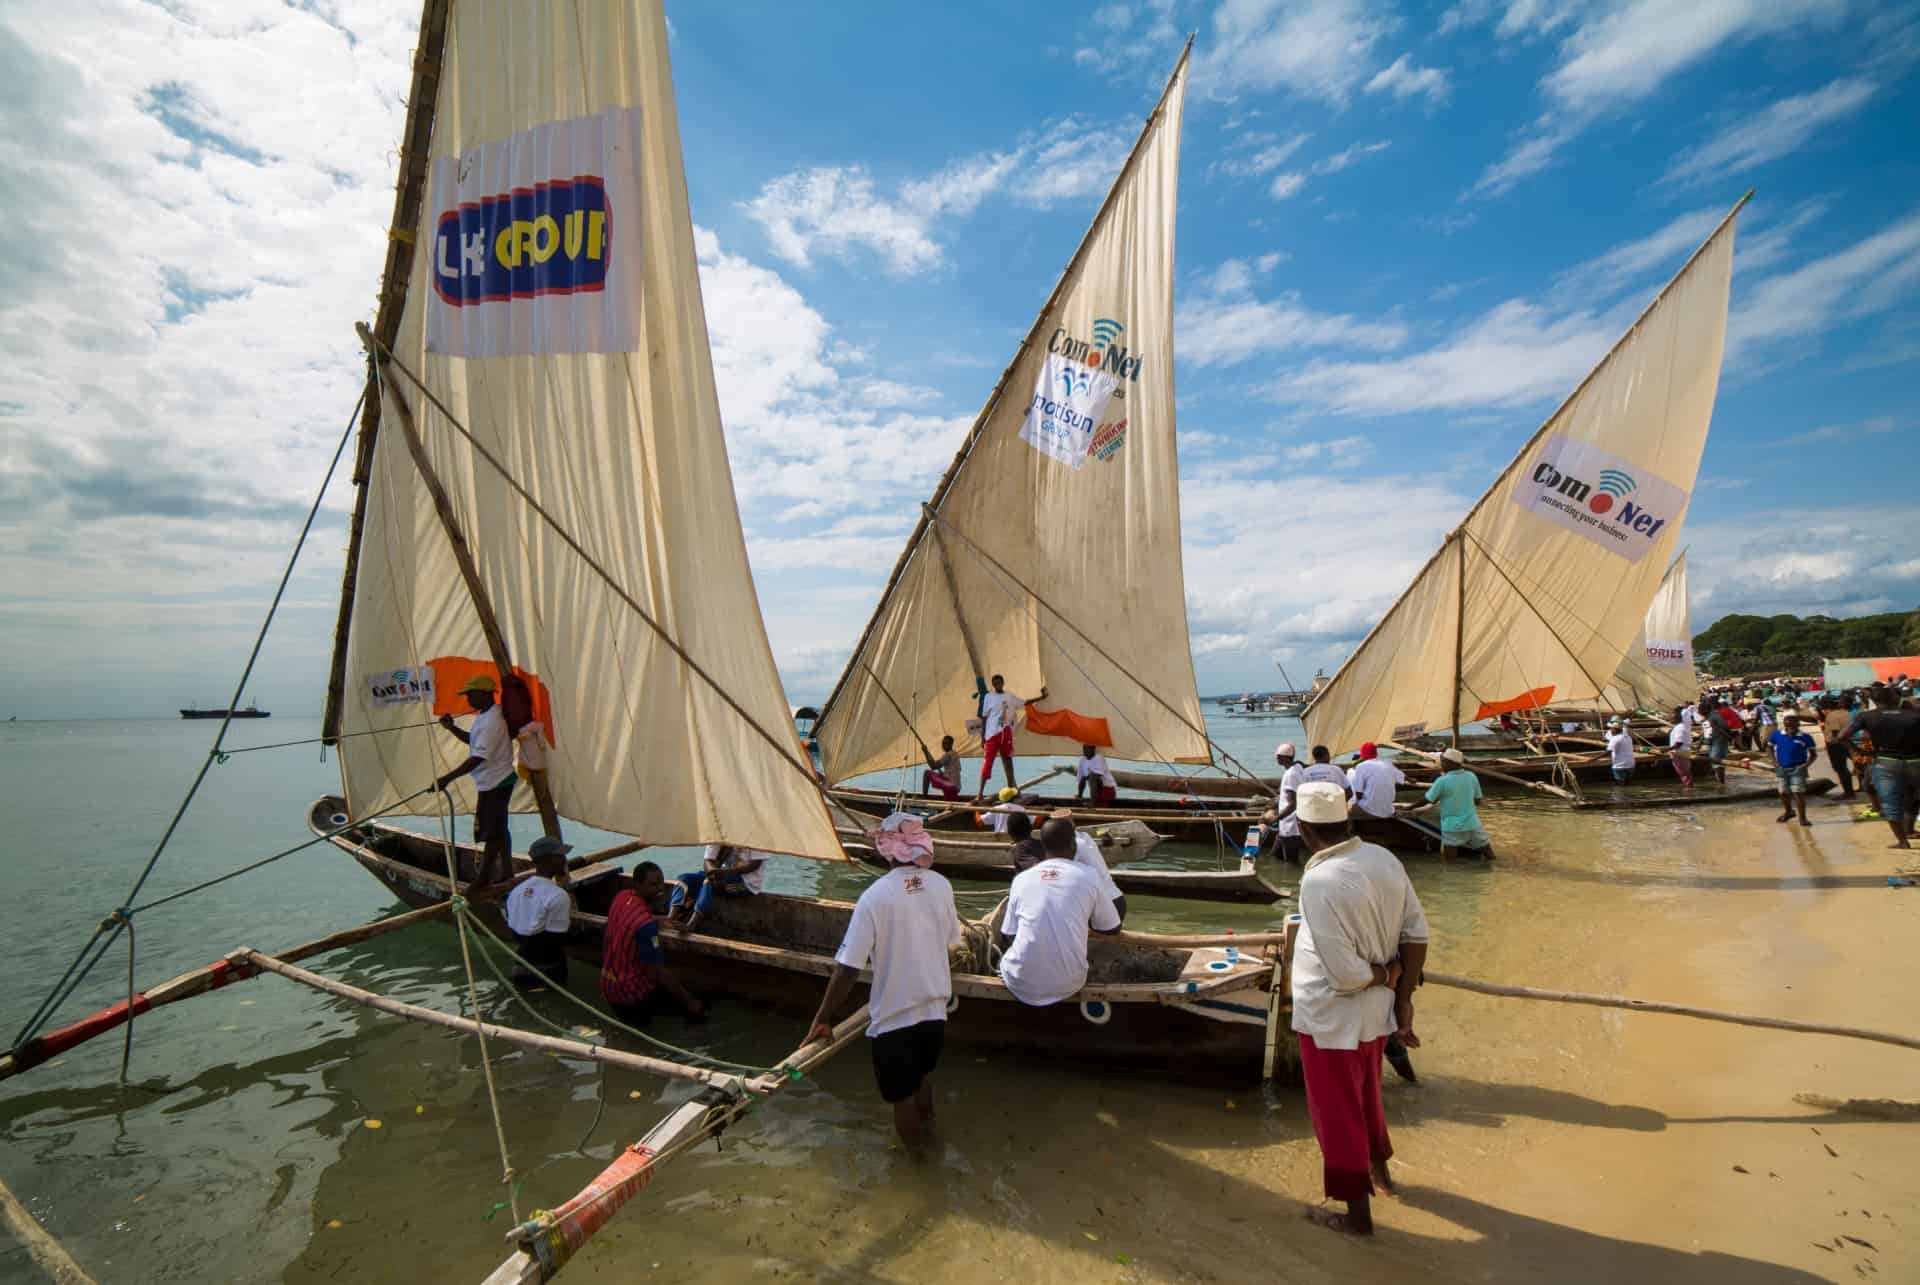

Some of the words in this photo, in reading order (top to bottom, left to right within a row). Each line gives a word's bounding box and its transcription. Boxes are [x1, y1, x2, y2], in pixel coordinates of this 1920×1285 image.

[438, 227, 485, 279] LK
[1048, 327, 1089, 363] Com
[1101, 339, 1144, 382] Net
[1533, 463, 1591, 502] Com
[1616, 501, 1665, 539] Net
